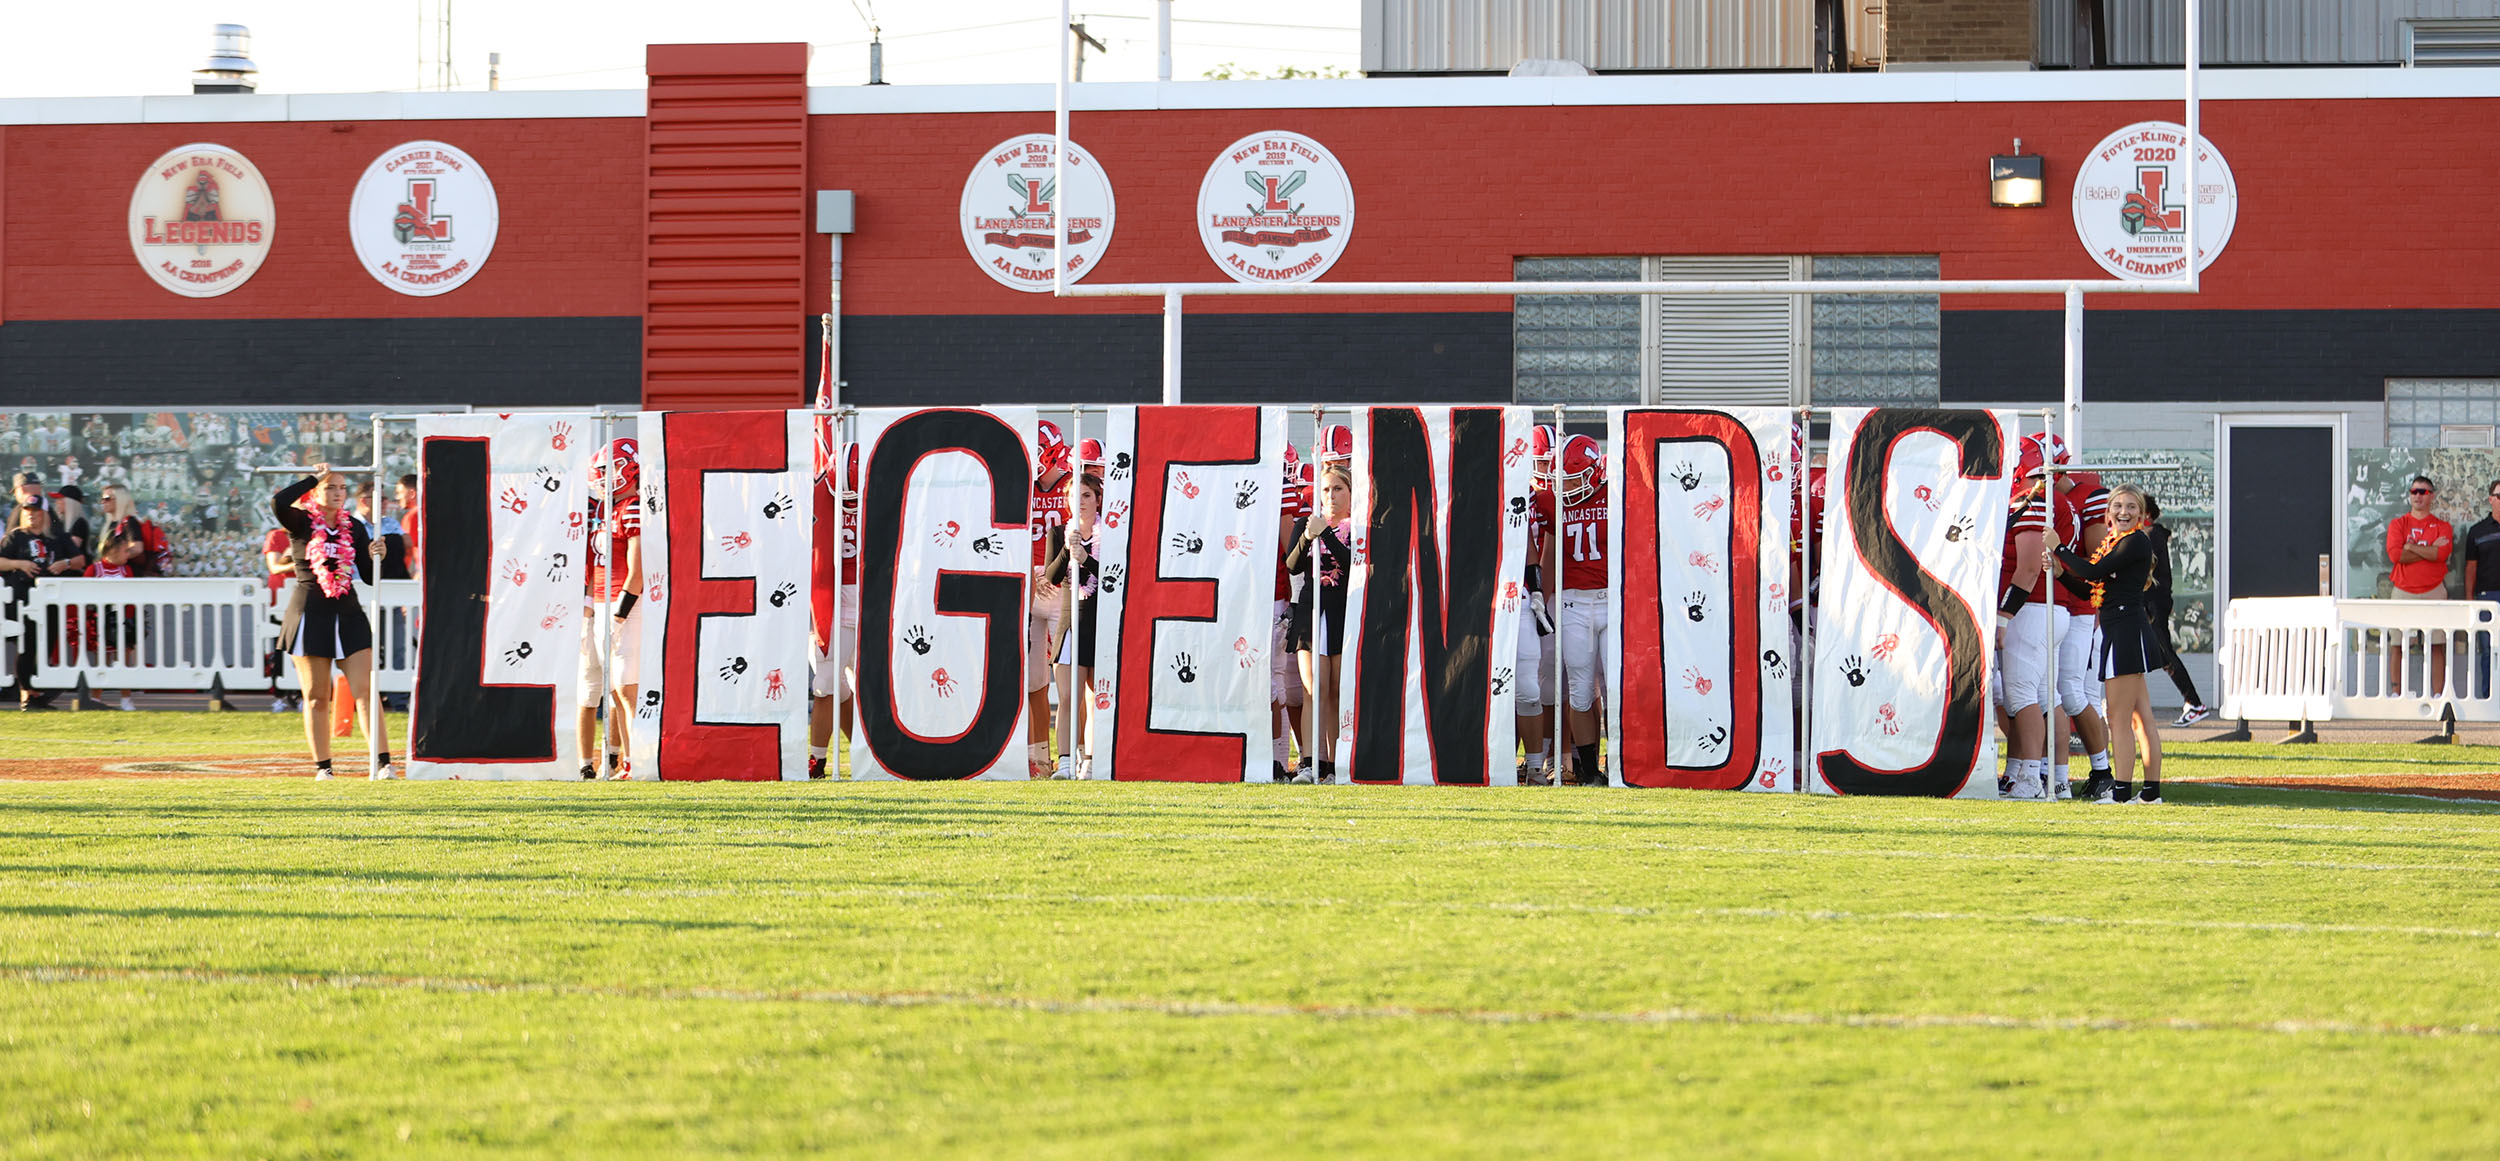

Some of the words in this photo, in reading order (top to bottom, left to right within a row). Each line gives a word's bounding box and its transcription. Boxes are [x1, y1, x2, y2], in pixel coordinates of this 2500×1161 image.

[2134, 148, 2176, 161] 2020
[143, 216, 263, 246] LEGENDS
[993, 256, 1011, 274] AA
[1227, 253, 1245, 271] AA
[1247, 252, 1323, 280] CHAMPIONS
[2105, 248, 2124, 267] AA
[179, 258, 244, 283] CHAMPIONS
[400, 259, 470, 284] CHAMPIONS
[1566, 522, 1602, 562] 71
[411, 405, 2005, 798] LEGENDS
[2184, 608, 2199, 623] 25
